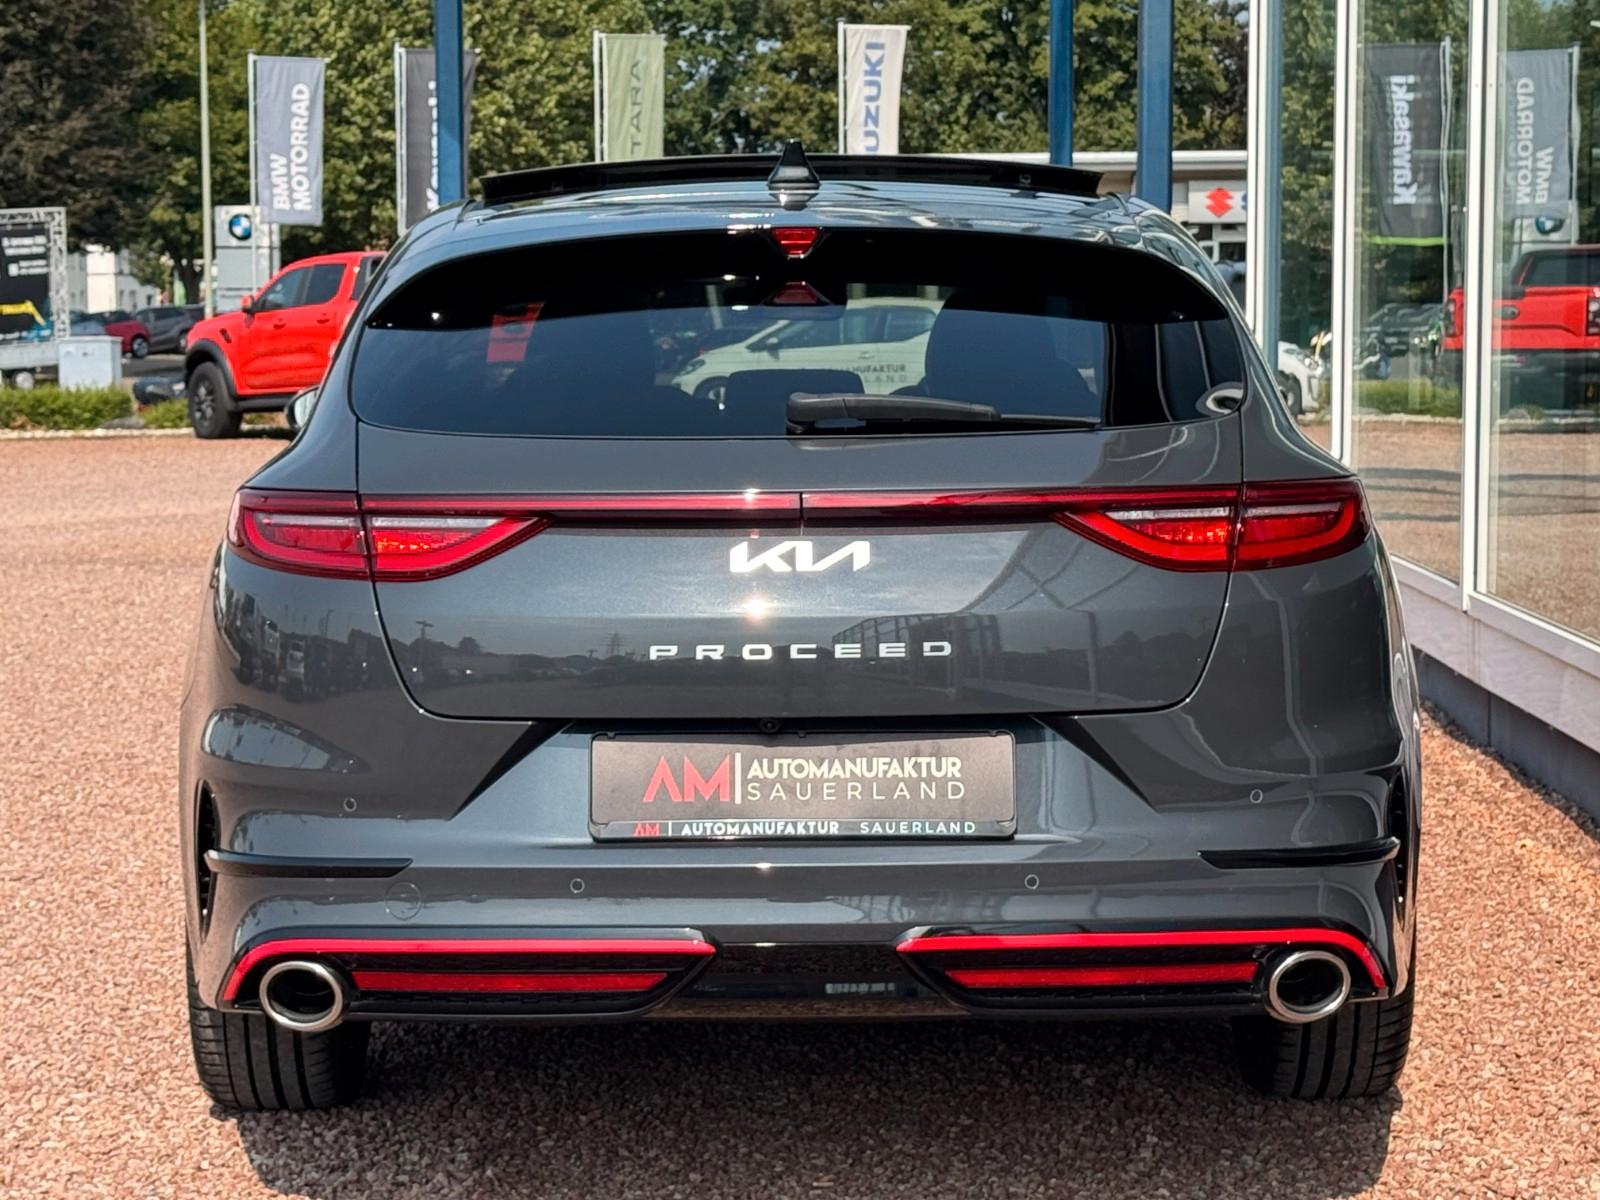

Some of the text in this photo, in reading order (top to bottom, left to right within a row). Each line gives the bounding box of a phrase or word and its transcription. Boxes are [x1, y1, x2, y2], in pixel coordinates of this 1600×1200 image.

[863, 42, 886, 154] UZUKI
[290, 82, 313, 212] MOTORRAD
[269, 152, 292, 211] BMW
[729, 541, 871, 573] KIA
[649, 641, 952, 660] PROCEED
[642, 755, 731, 802] AM
[747, 757, 962, 780] AUTOMANUFAKTUR
[747, 781, 966, 801] SAUERLAND
[632, 821, 977, 837] AM AUTOMANUFAKTUR SAUERLAND
